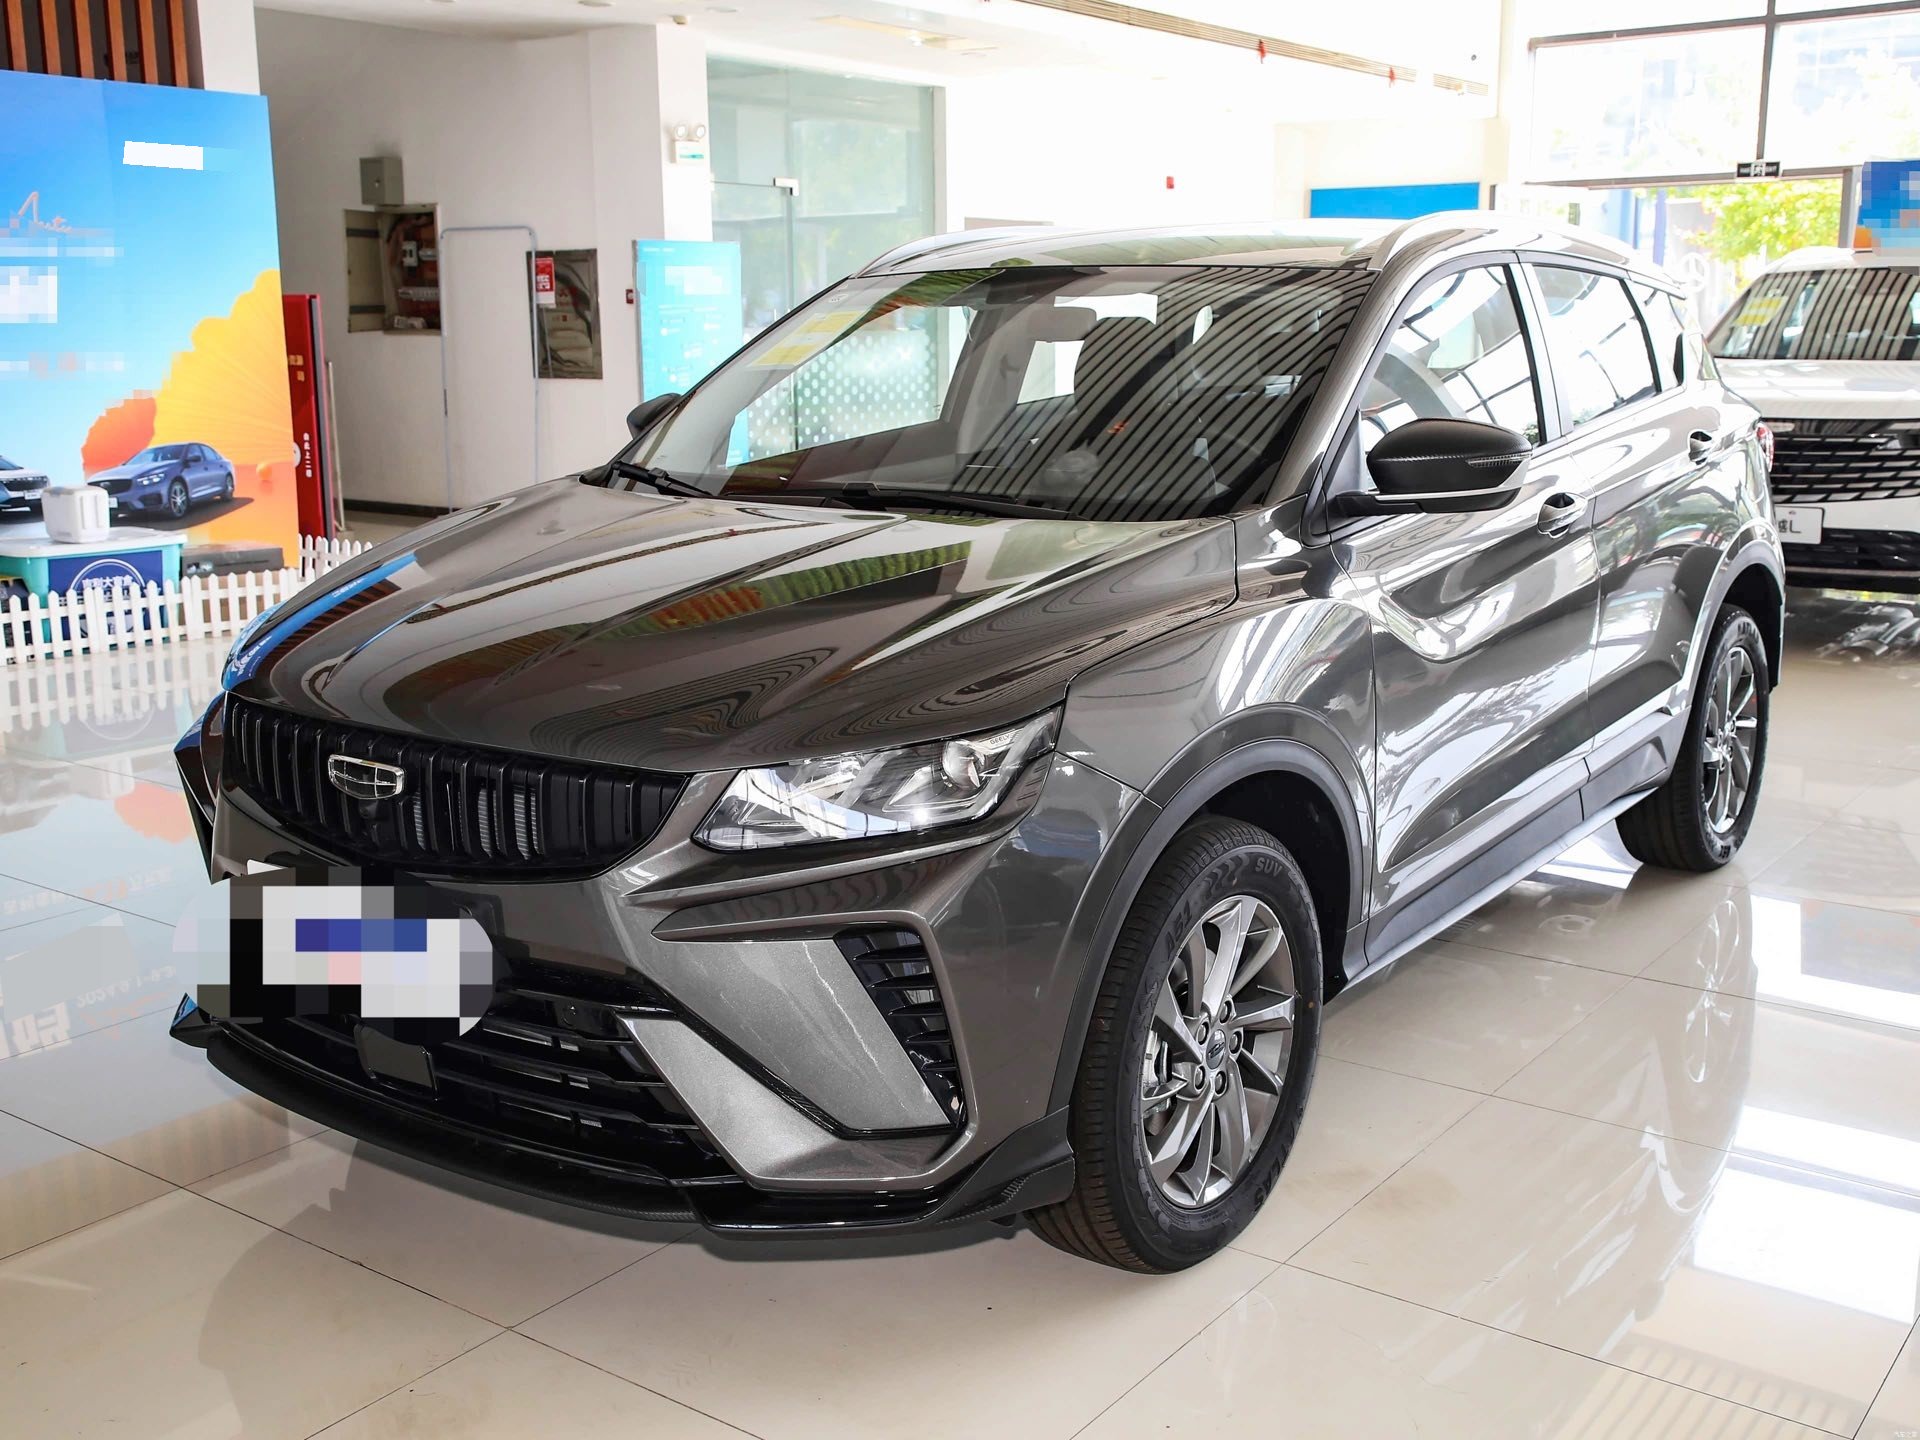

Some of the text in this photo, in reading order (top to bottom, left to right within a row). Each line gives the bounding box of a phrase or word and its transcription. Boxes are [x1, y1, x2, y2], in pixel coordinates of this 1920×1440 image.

[990, 733, 1010, 744] GEELY
[1255, 857, 1283, 877] SUV
[1165, 899, 1192, 960] A51
